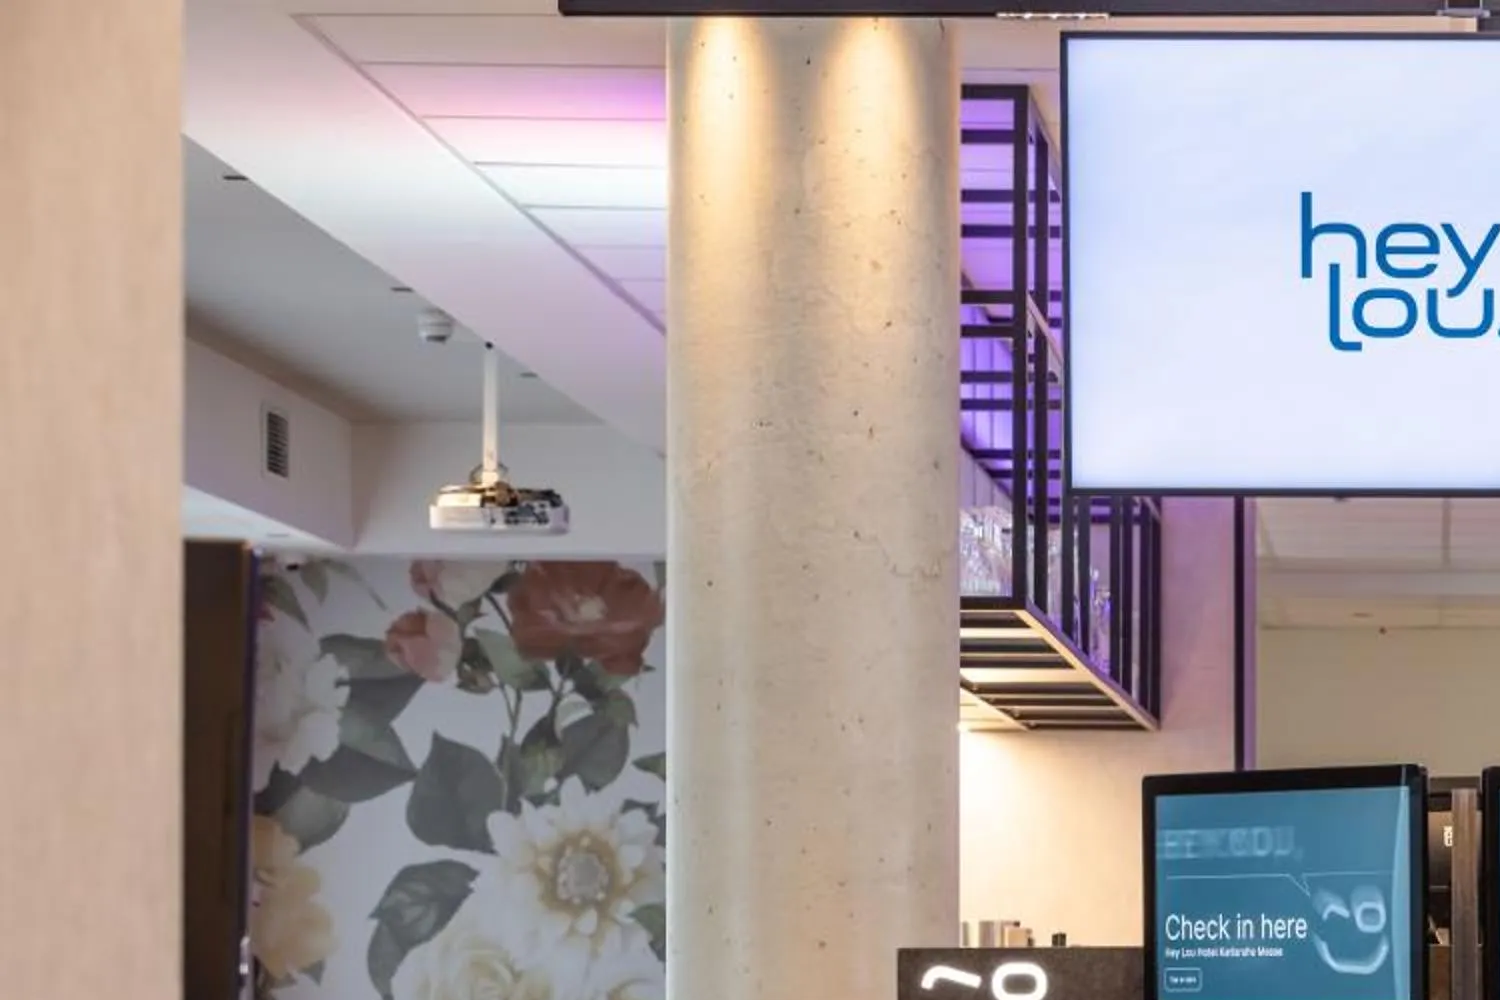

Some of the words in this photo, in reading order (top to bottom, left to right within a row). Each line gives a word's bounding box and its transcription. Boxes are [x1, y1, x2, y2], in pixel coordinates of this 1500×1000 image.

[1165, 913, 1231, 941] Check
[1236, 912, 1255, 940] in
[1261, 912, 1308, 940] here
